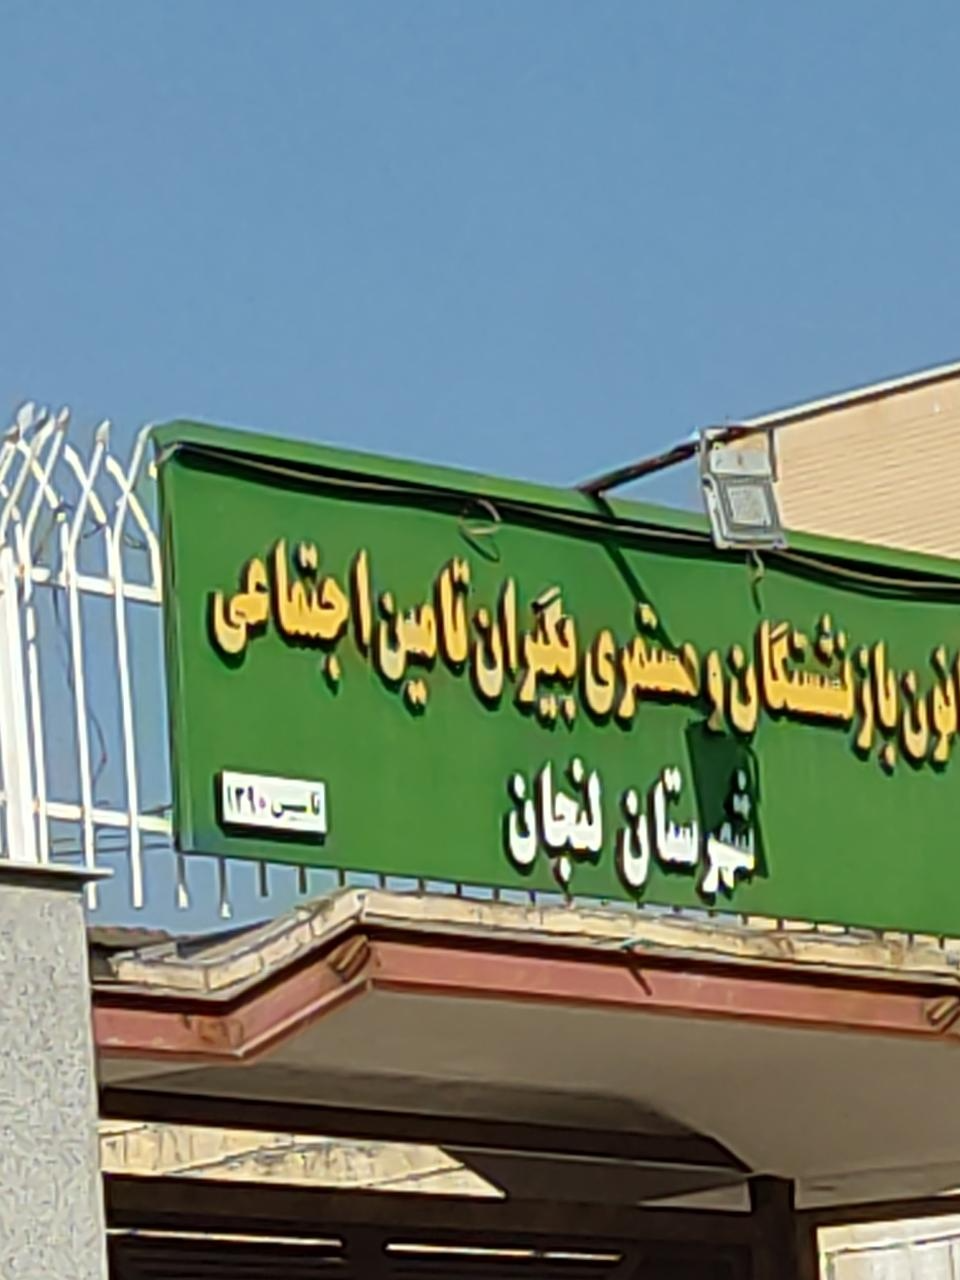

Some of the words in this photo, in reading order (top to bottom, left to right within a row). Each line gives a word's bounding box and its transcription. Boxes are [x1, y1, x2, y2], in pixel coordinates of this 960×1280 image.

[213, 537, 372, 681] اجتماعی
[475, 576, 577, 720] بگیران
[585, 601, 699, 719] مستمری
[706, 649, 724, 732] و
[730, 612, 897, 768] بازنشستگان
[508, 756, 603, 883] لنجان
[622, 765, 755, 893] شهرستان
